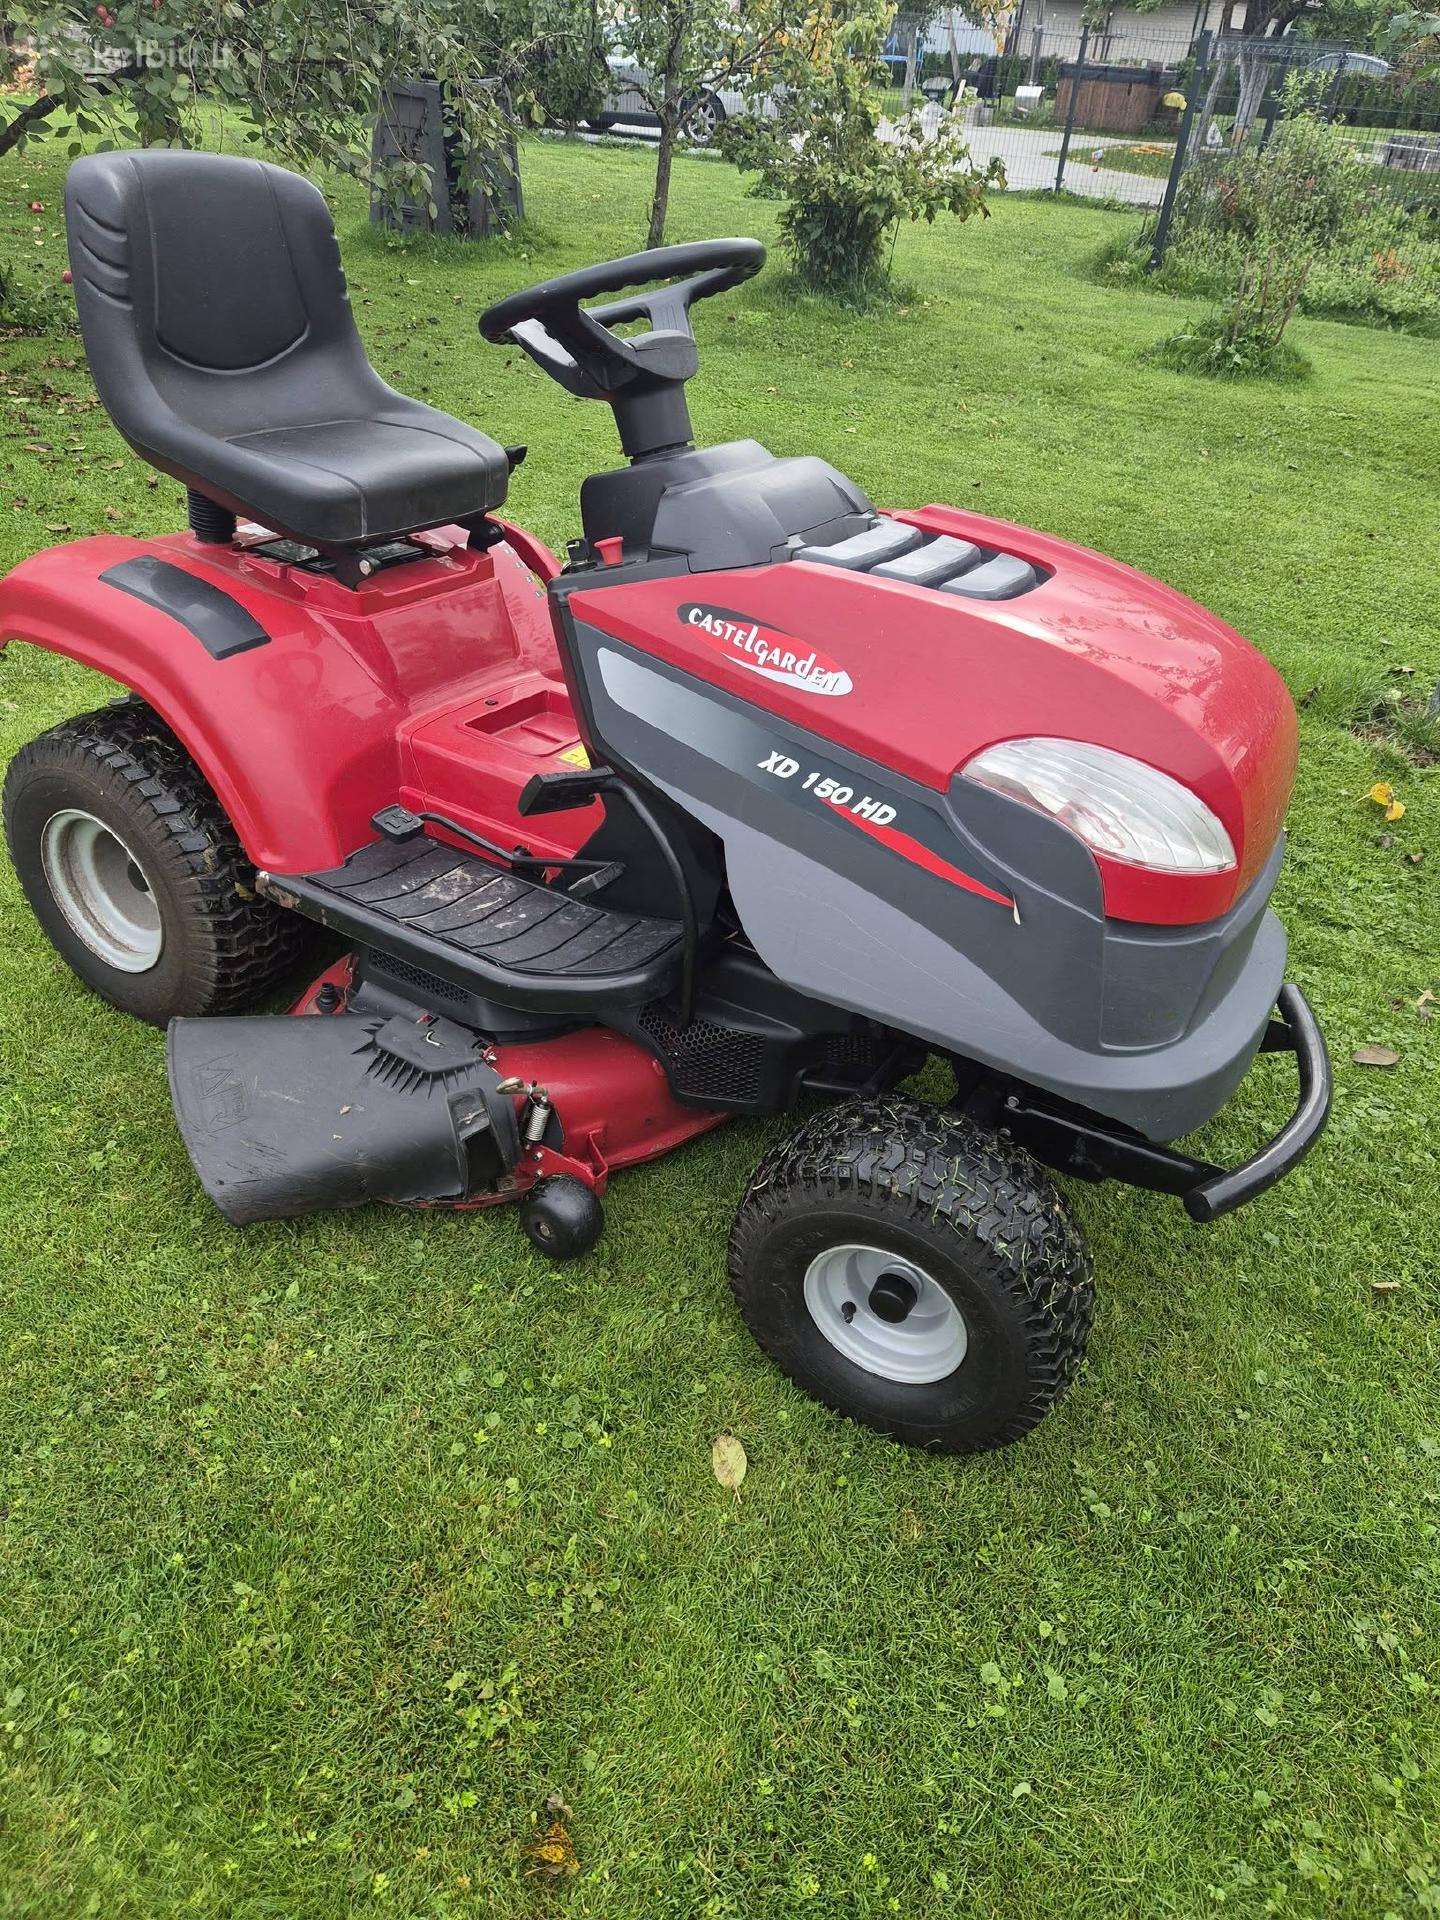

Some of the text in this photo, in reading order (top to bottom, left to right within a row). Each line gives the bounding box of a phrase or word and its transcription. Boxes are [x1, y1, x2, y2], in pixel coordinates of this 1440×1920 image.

[757, 750, 897, 826] XD 150 HD
